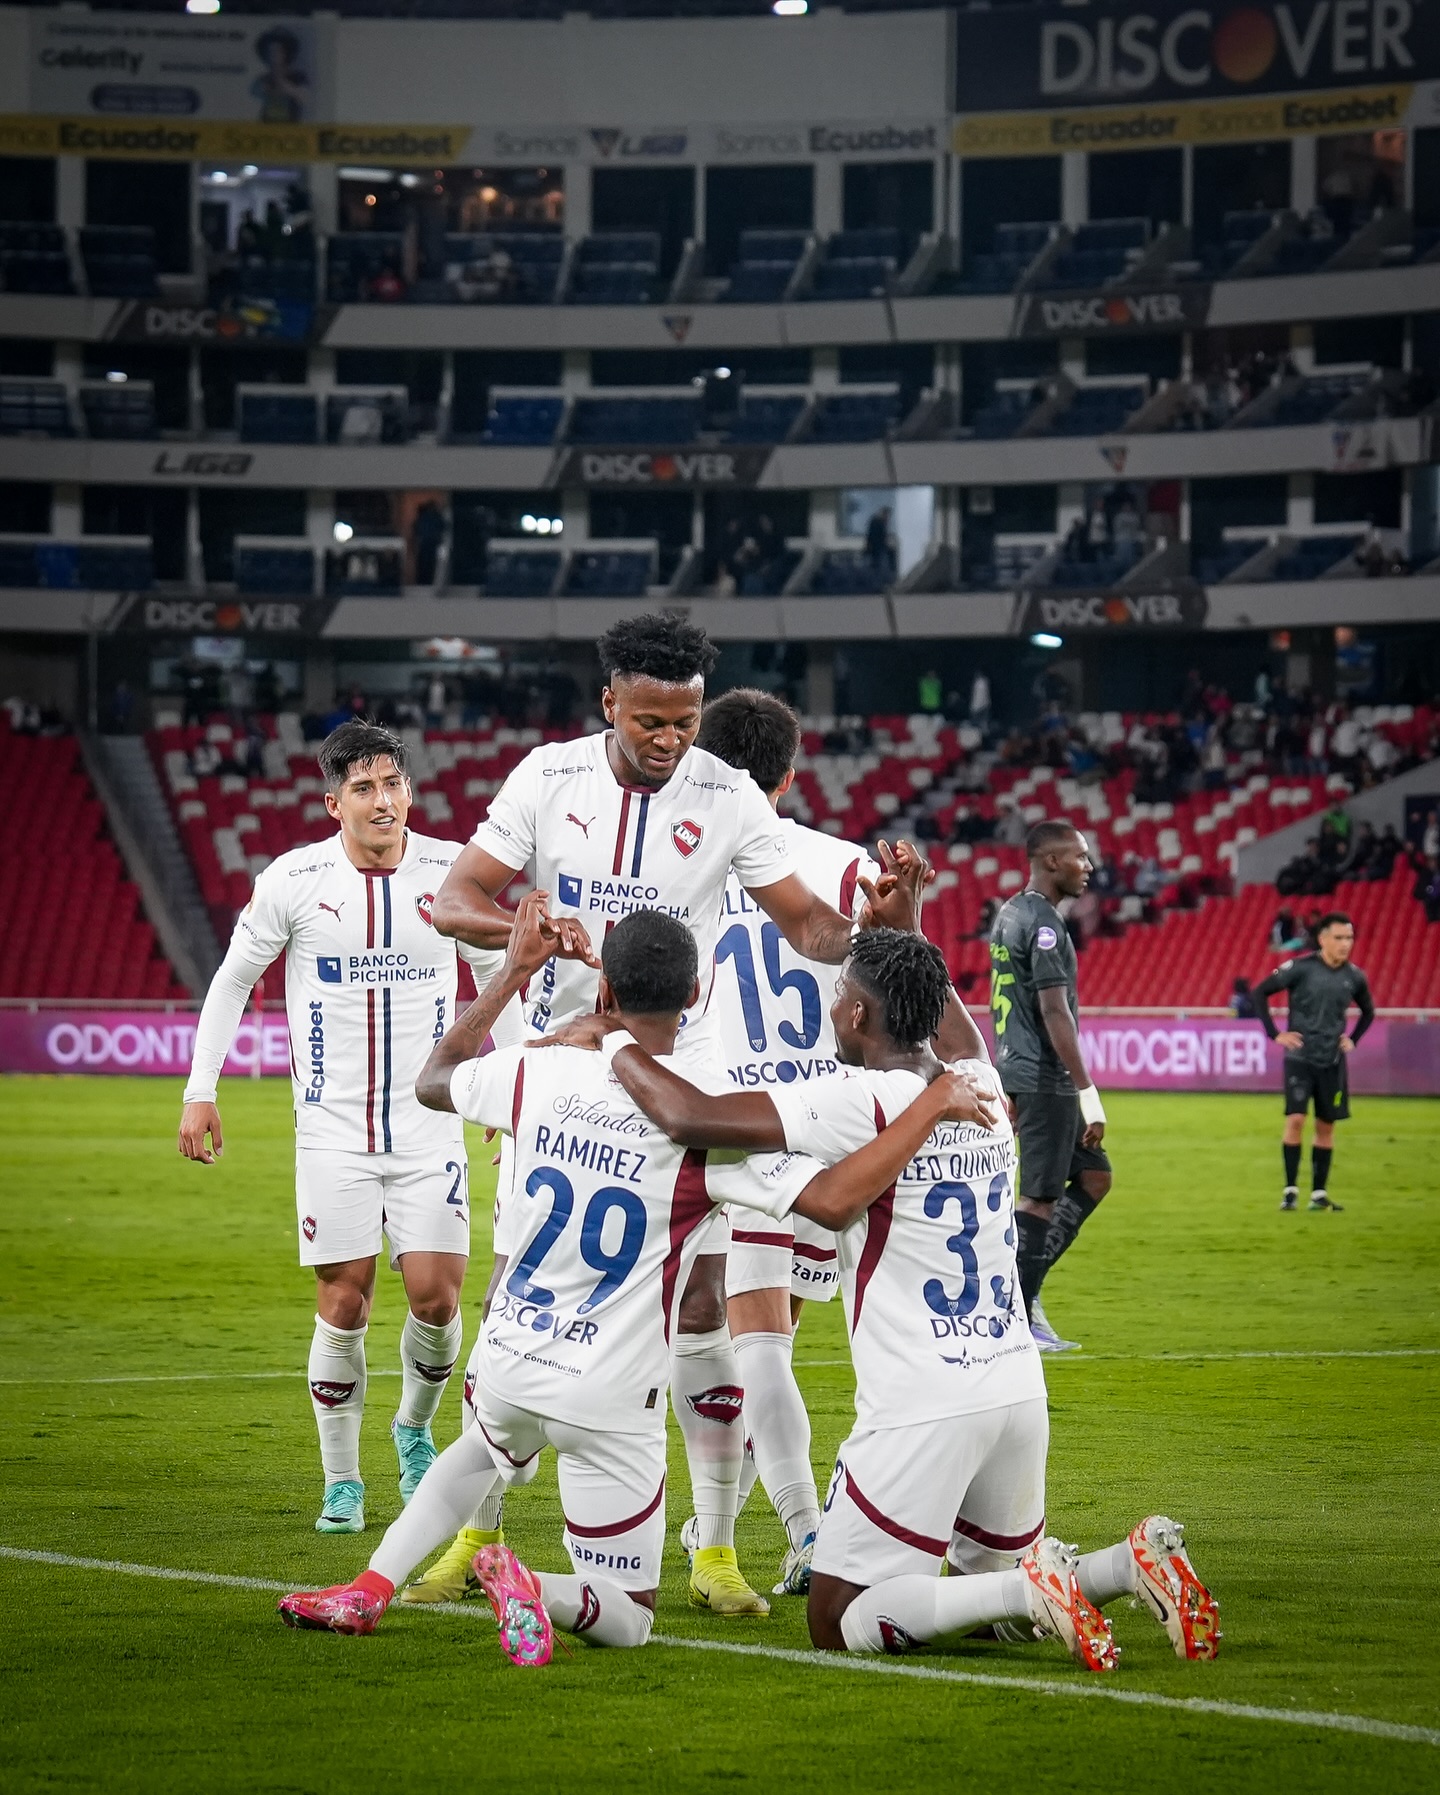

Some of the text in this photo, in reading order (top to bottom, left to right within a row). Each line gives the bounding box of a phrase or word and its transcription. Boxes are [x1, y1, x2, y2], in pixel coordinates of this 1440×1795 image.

[1039, 0, 1416, 95] DISCOVER
[1052, 112, 1178, 145] Ecuador
[1283, 94, 1398, 129] Ecuabet
[60, 123, 199, 149] Ecuador
[318, 128, 452, 157] Ecuabet
[809, 125, 937, 153] Ecuabet
[1042, 294, 1184, 329] DISCOVER
[582, 453, 735, 482] DISCOVER
[145, 601, 300, 630] DISCOVER
[1041, 596, 1182, 626] DISCOVER
[543, 765, 594, 776] CHERY
[684, 775, 739, 794] CHERY
[289, 862, 336, 877] CHERY
[591, 880, 658, 900] BANCO
[350, 954, 409, 968] BANCO
[350, 967, 436, 983] PICHINCHA
[715, 922, 822, 1053] 15
[305, 1000, 325, 1103] Ecuabet
[553, 1094, 650, 1138] Splendor
[536, 1125, 647, 1183] RAMIREZ
[506, 1166, 648, 1315] 29
[490, 1294, 599, 1345] DISCOVER
[523, 1352, 582, 1376] Constitución
